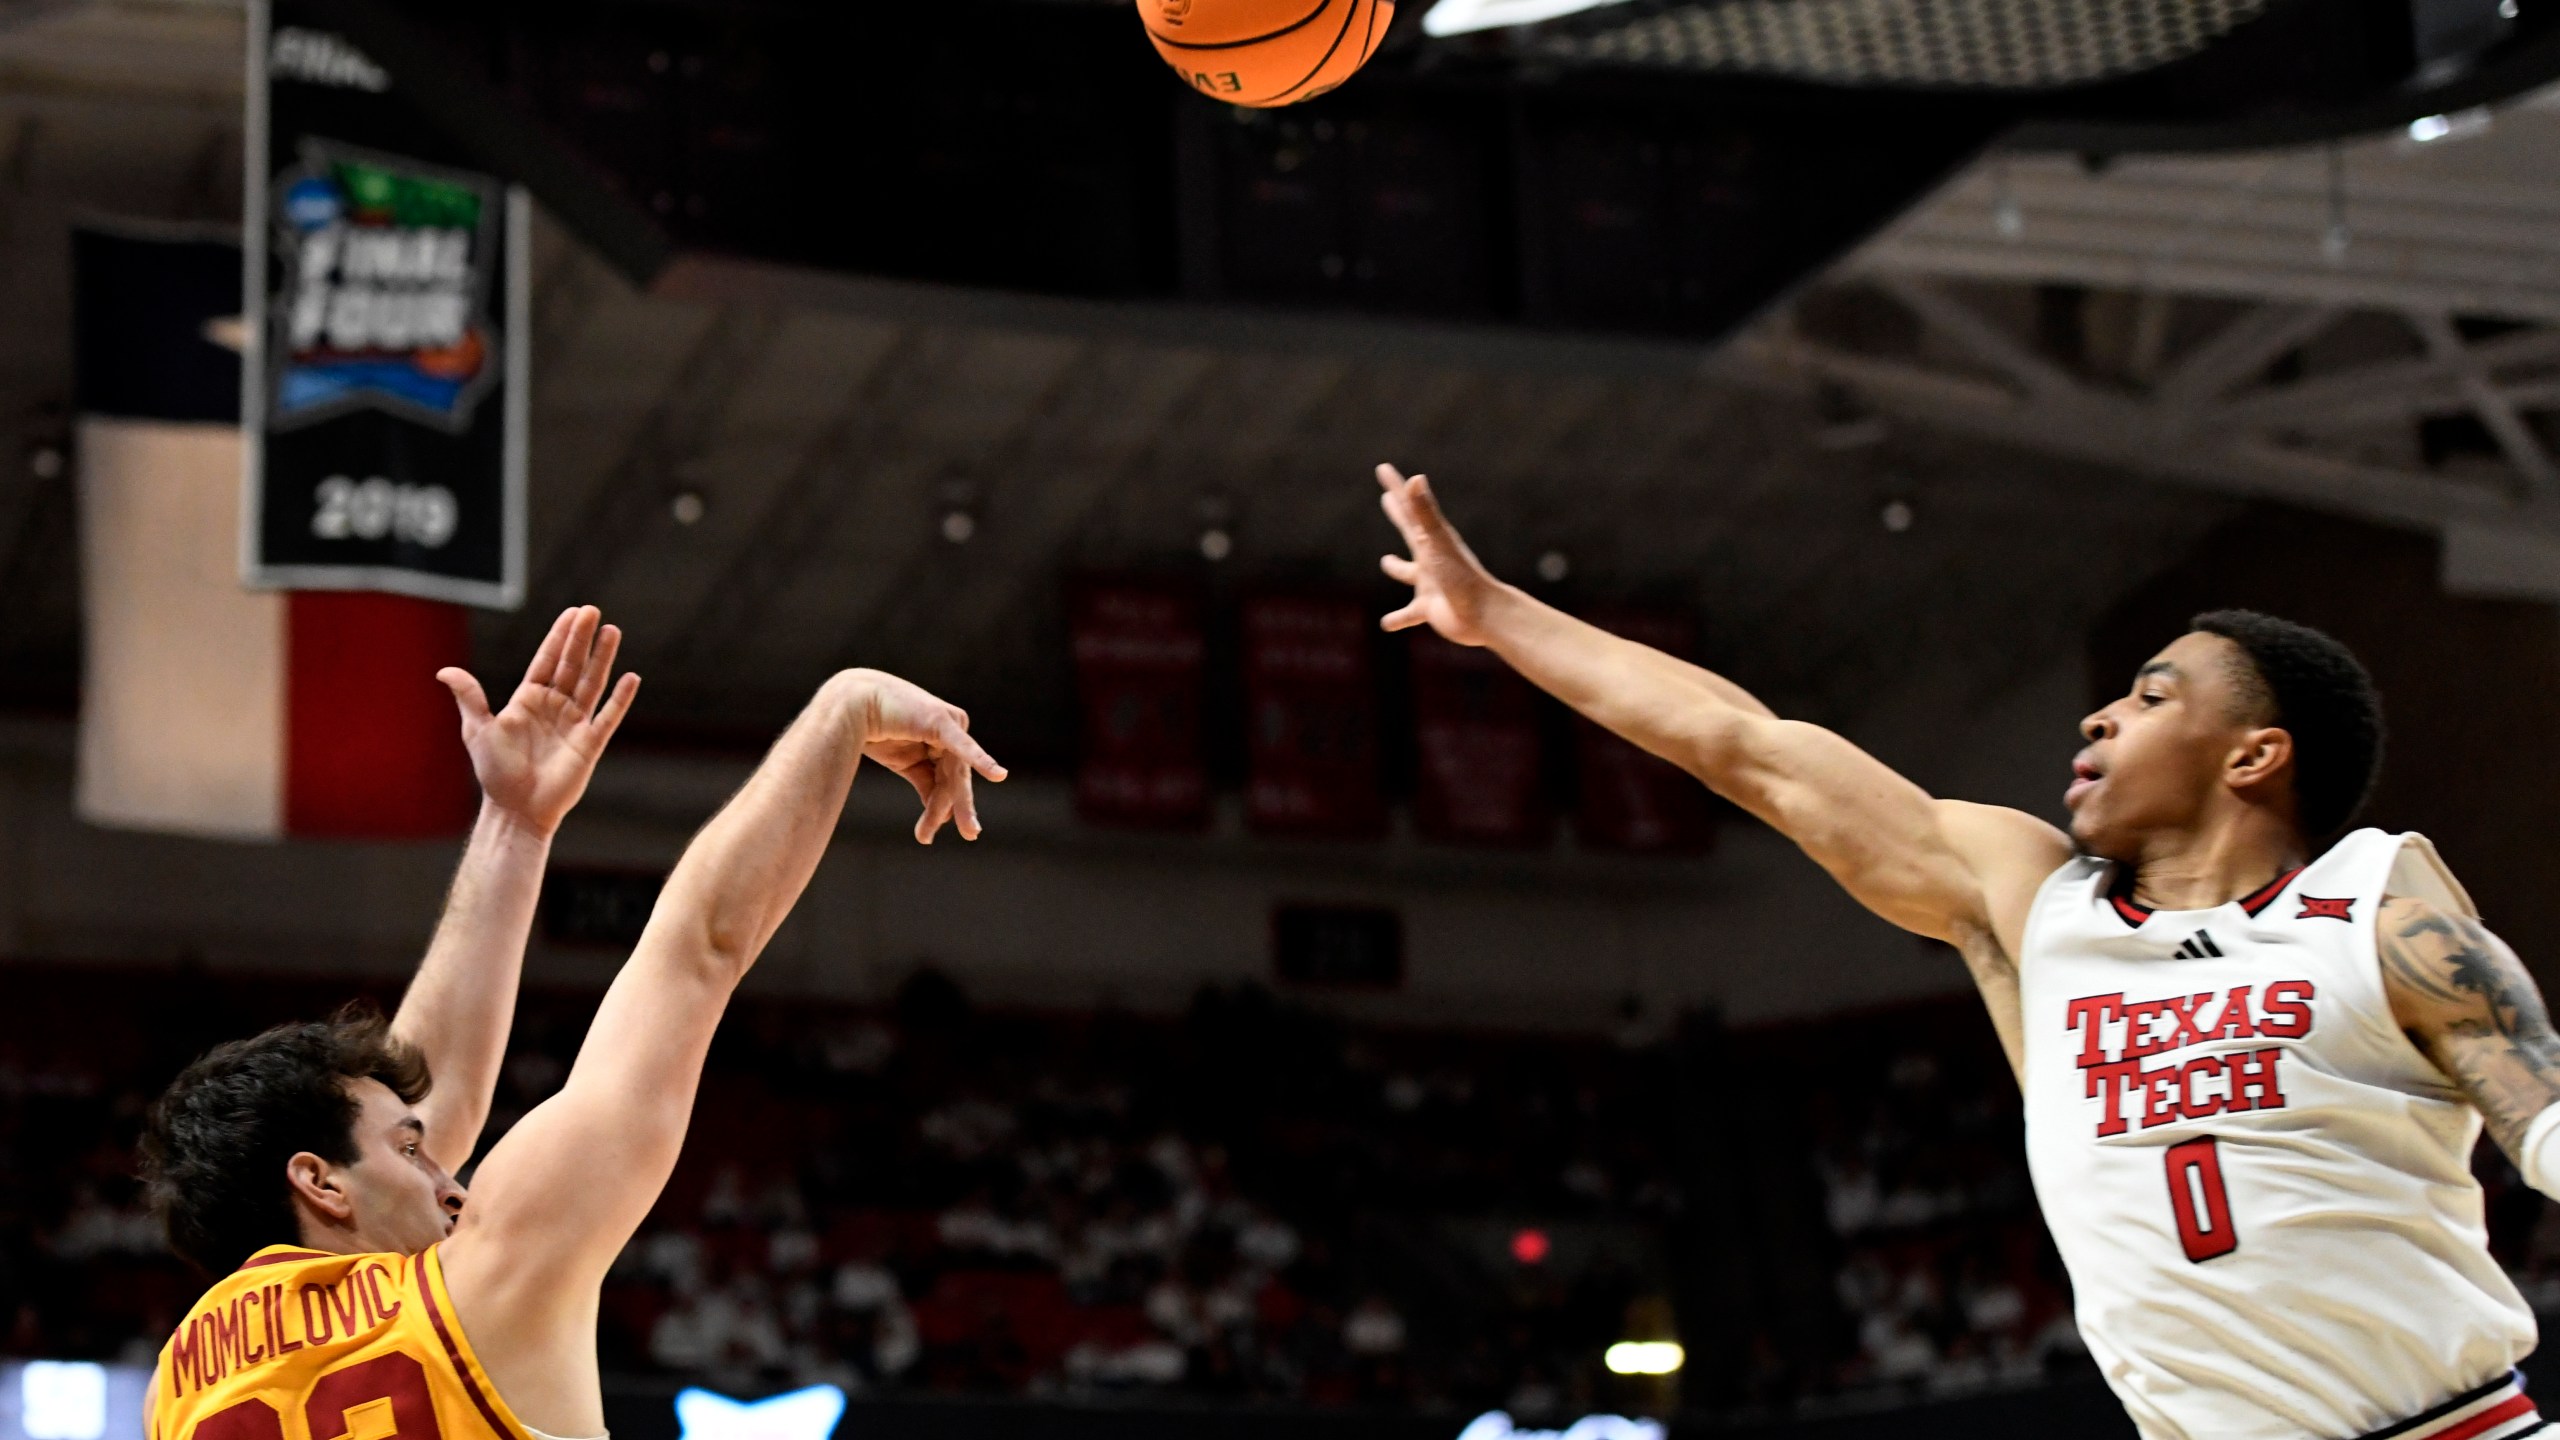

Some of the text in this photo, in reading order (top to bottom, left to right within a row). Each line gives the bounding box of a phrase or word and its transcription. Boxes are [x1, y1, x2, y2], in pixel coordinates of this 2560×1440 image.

[302, 228, 469, 282] FINAL
[289, 288, 466, 349] FOUR
[311, 475, 458, 547] 2019
[2066, 979, 2316, 1069] TEXAS
[2085, 1047, 2287, 1138] TECH
[2164, 1134, 2238, 1264] 0
[171, 1262, 402, 1399] MOMCILOVIC
